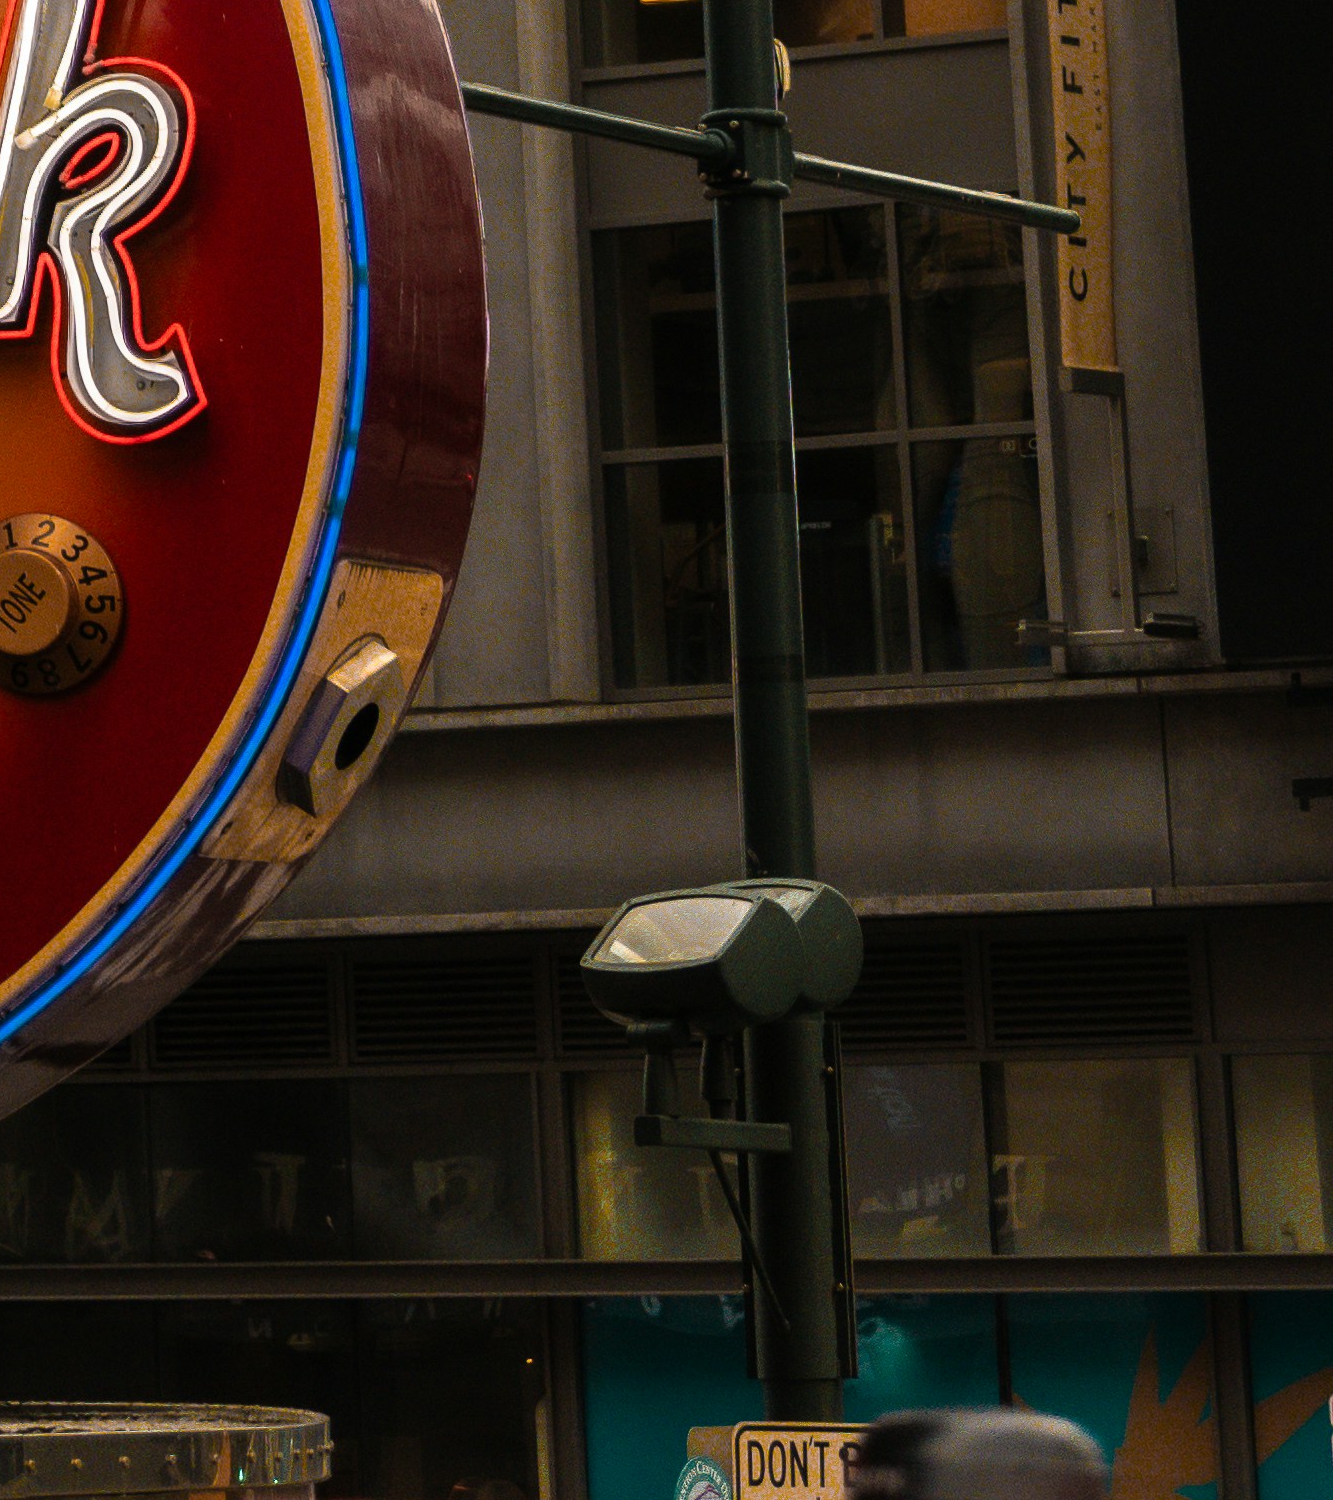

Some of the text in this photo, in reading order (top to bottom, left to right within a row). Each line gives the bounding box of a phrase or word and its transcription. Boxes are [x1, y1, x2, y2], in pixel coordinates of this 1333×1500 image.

[1092, 73, 1103, 132] EAST
[1063, 131, 1089, 302] CITY
[3, 522, 19, 549] 1
[31, 520, 55, 548] 2
[61, 535, 89, 562] 3
[78, 565, 108, 586] 4
[85, 594, 116, 614] 5
[78, 620, 108, 644] 6
[66, 642, 93, 672] 7
[36, 658, 60, 686] 8
[746, 1435, 830, 1488] DON'T
